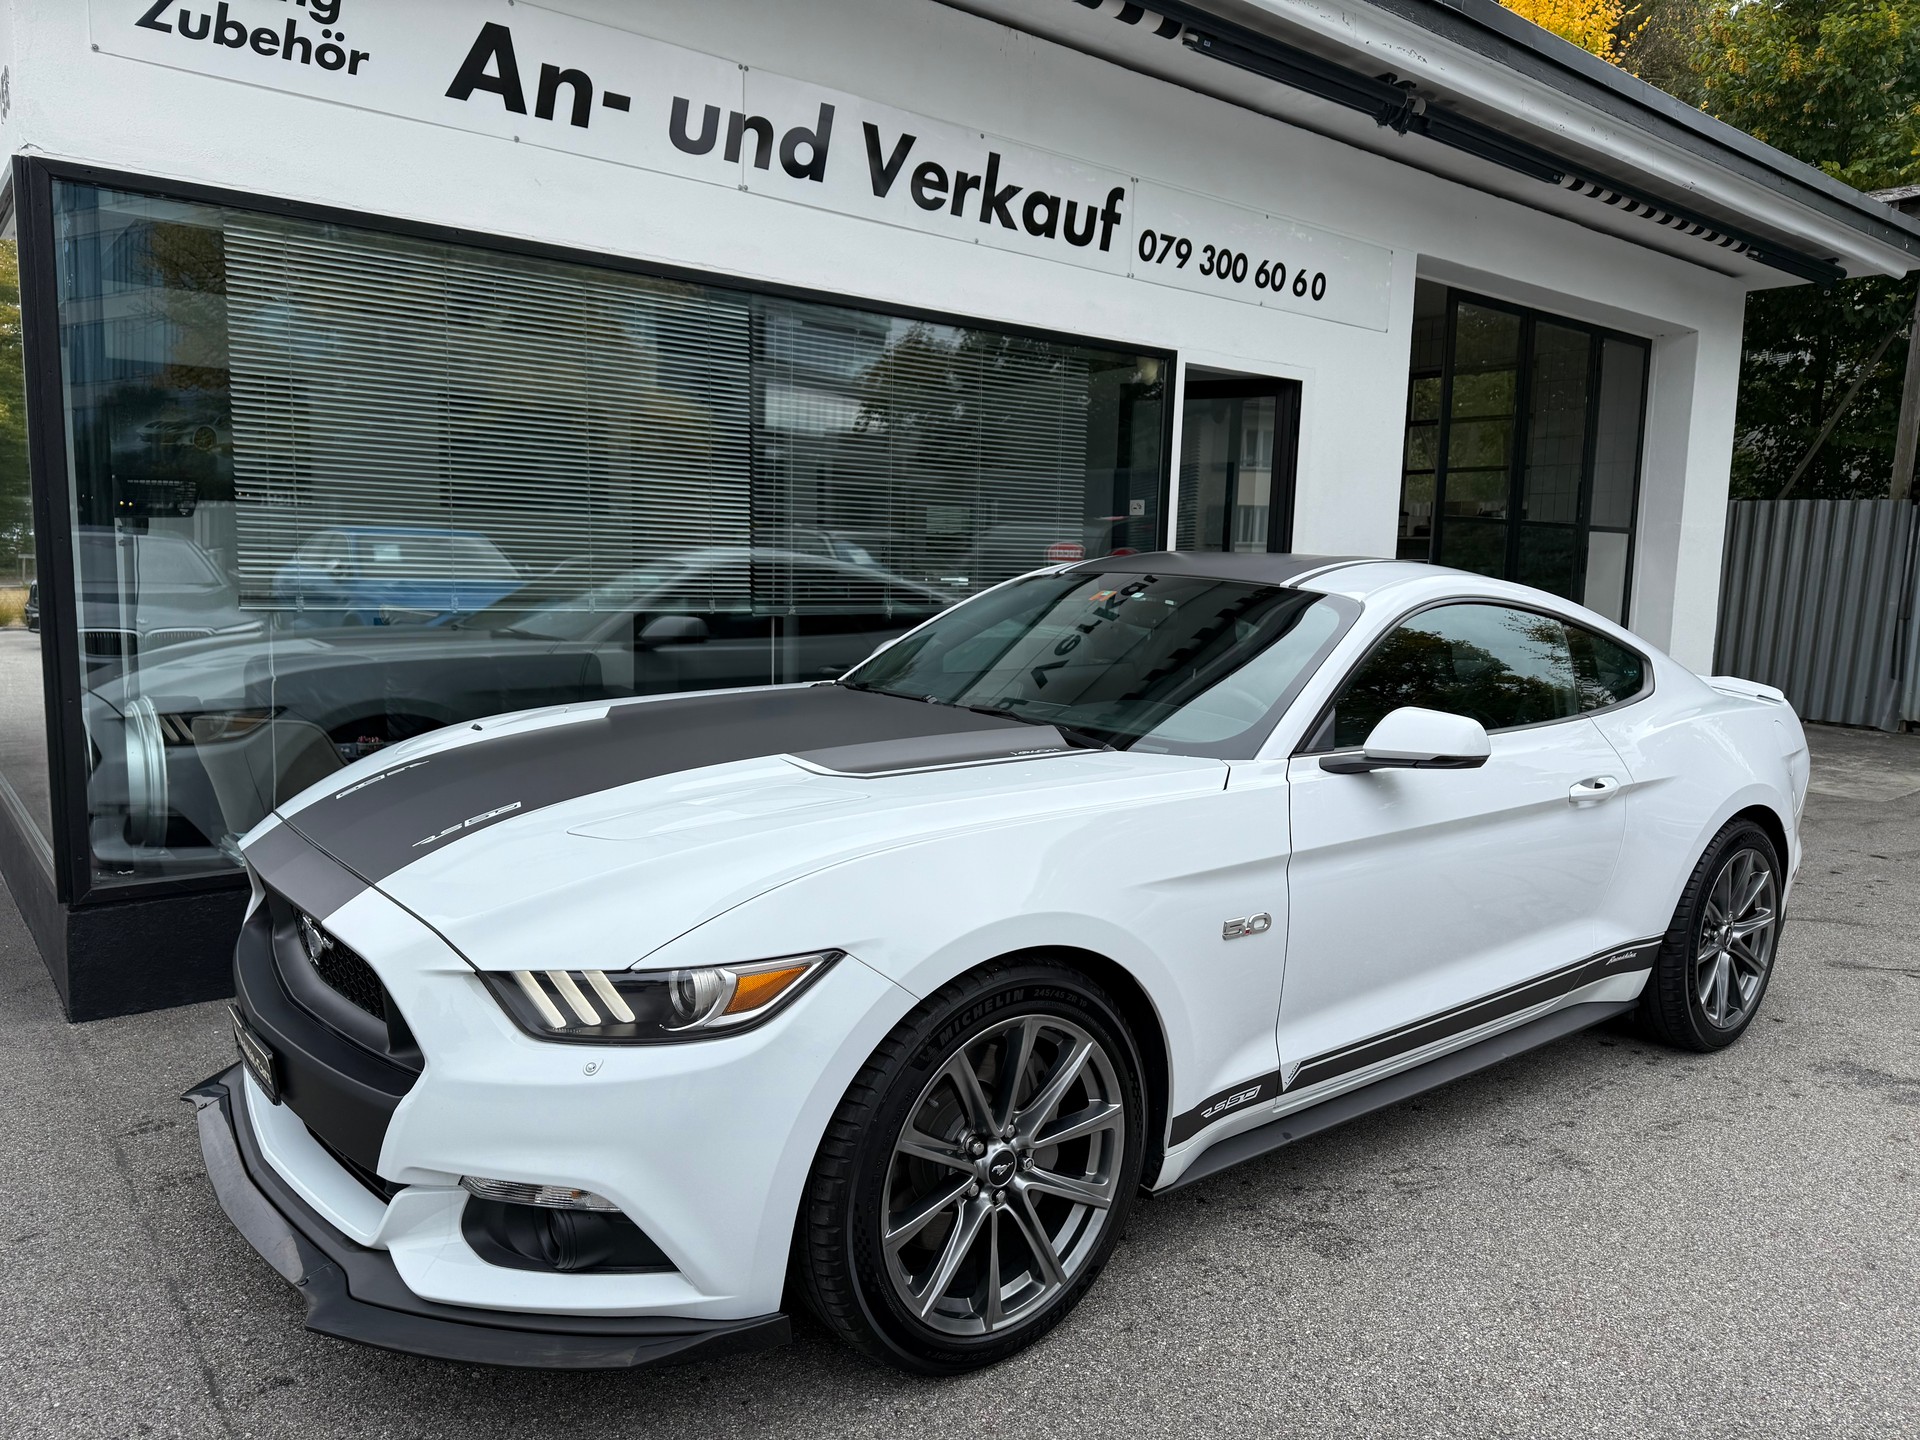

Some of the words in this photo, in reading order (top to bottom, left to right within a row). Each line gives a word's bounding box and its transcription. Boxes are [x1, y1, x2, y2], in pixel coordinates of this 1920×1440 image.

[134, 0, 370, 76] Zubehör
[445, 21, 631, 129] An-
[669, 94, 835, 183] und
[862, 121, 1125, 252] Verkauf
[1138, 229, 1193, 269] 079
[1199, 244, 1249, 283] 300
[1255, 259, 1287, 293] 60
[1292, 268, 1327, 301] 60
[1222, 911, 1272, 941] 5.0
[939, 988, 1025, 1047] MICHELIN
[1033, 988, 1066, 999] 245/45
